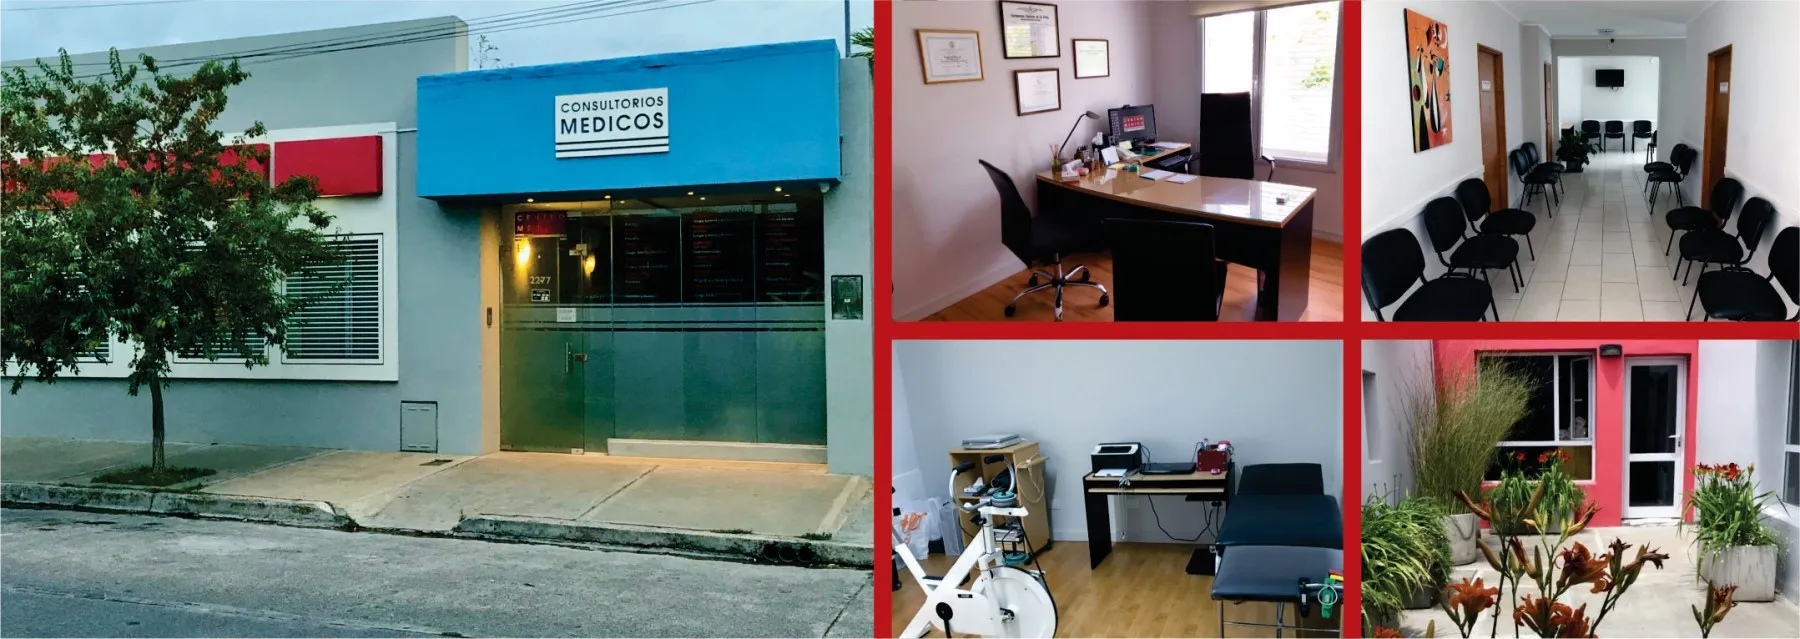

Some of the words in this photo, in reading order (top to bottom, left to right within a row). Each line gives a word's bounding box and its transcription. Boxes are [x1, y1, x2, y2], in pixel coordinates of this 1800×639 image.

[560, 96, 664, 113] CONSULTORIOS
[560, 112, 664, 135] MEDICOS
[530, 276, 551, 285] 2277
